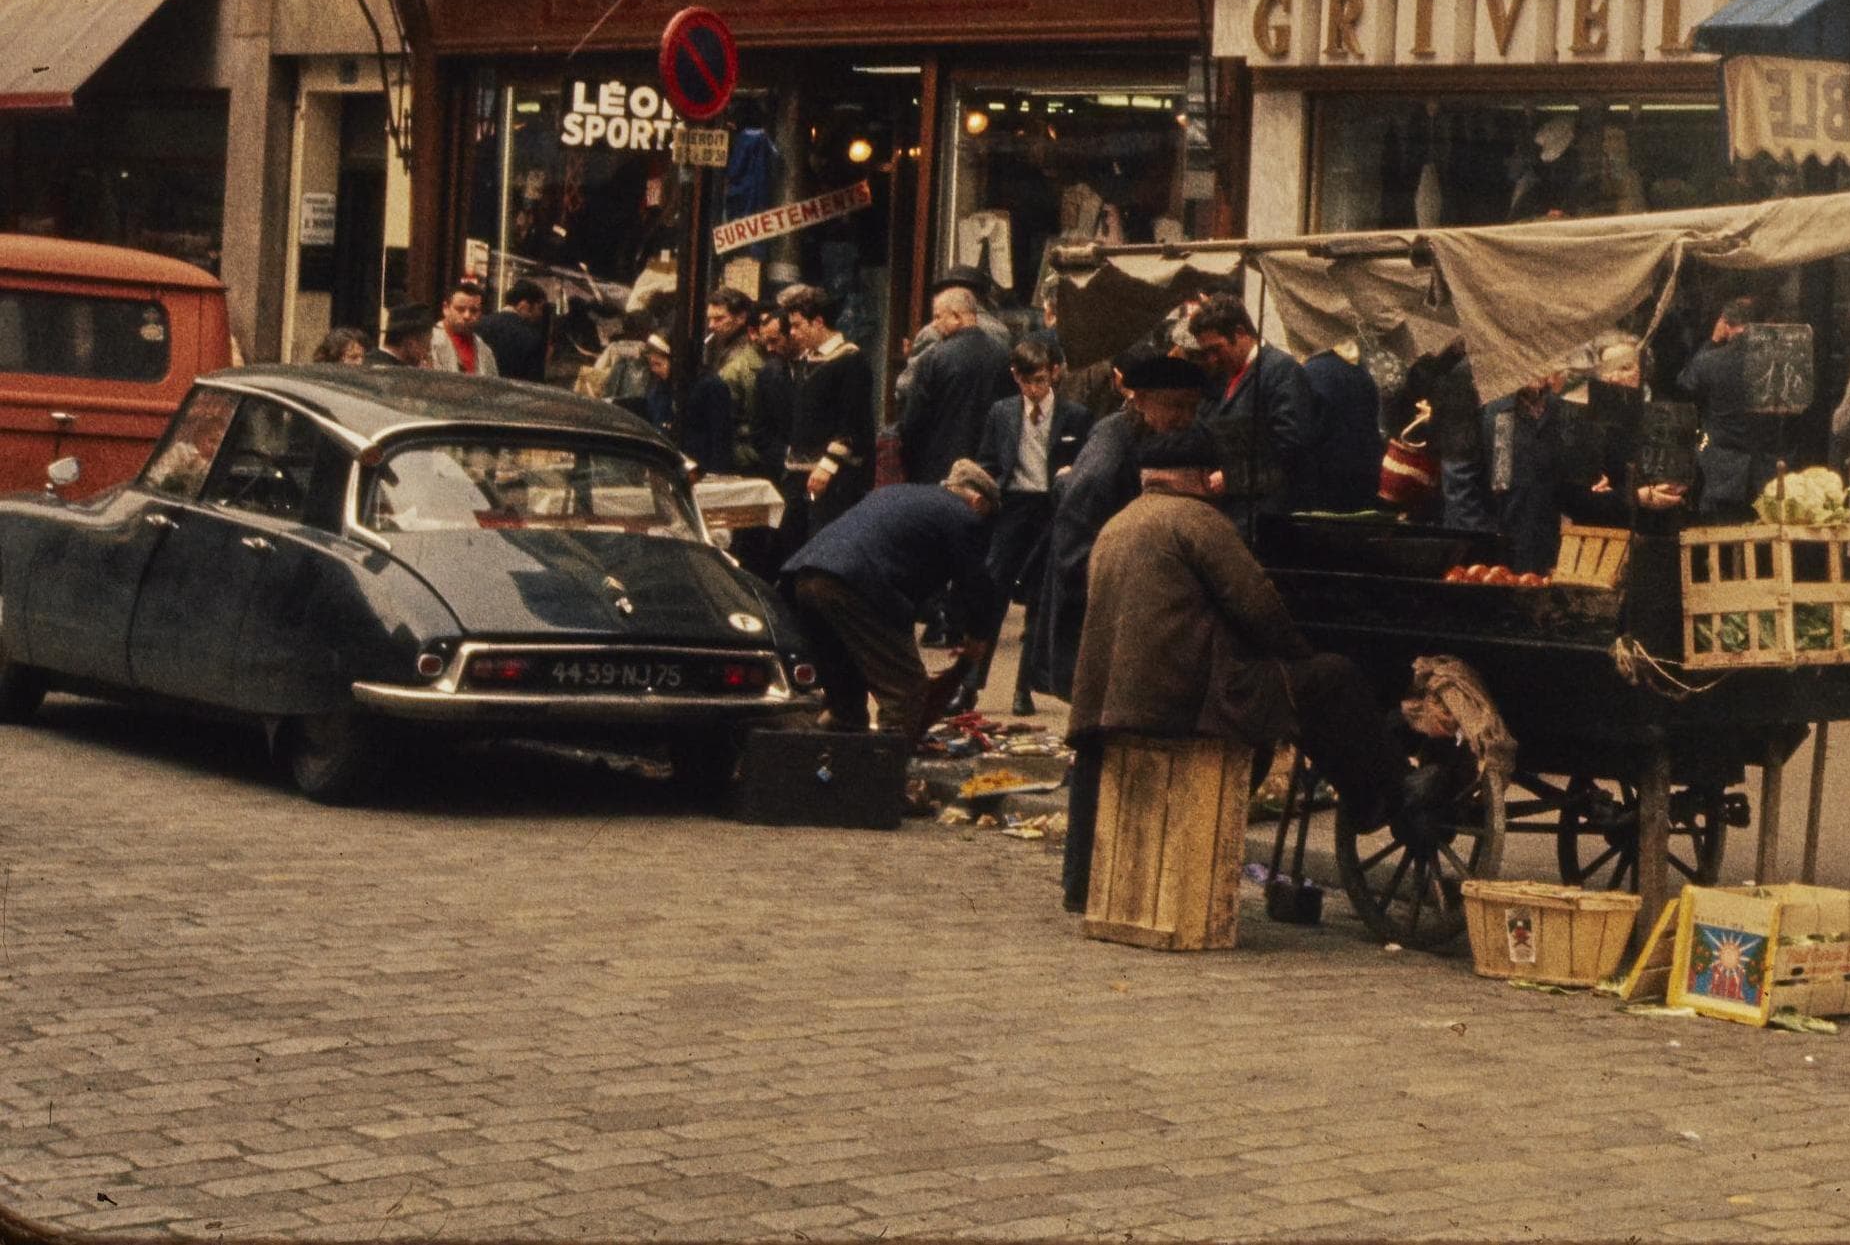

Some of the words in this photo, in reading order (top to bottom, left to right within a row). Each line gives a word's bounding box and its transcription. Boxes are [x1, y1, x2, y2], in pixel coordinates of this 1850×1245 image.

[572, 80, 674, 120] LÉO
[561, 112, 686, 151] SPORT
[715, 182, 869, 249] SURVETEMENTS
